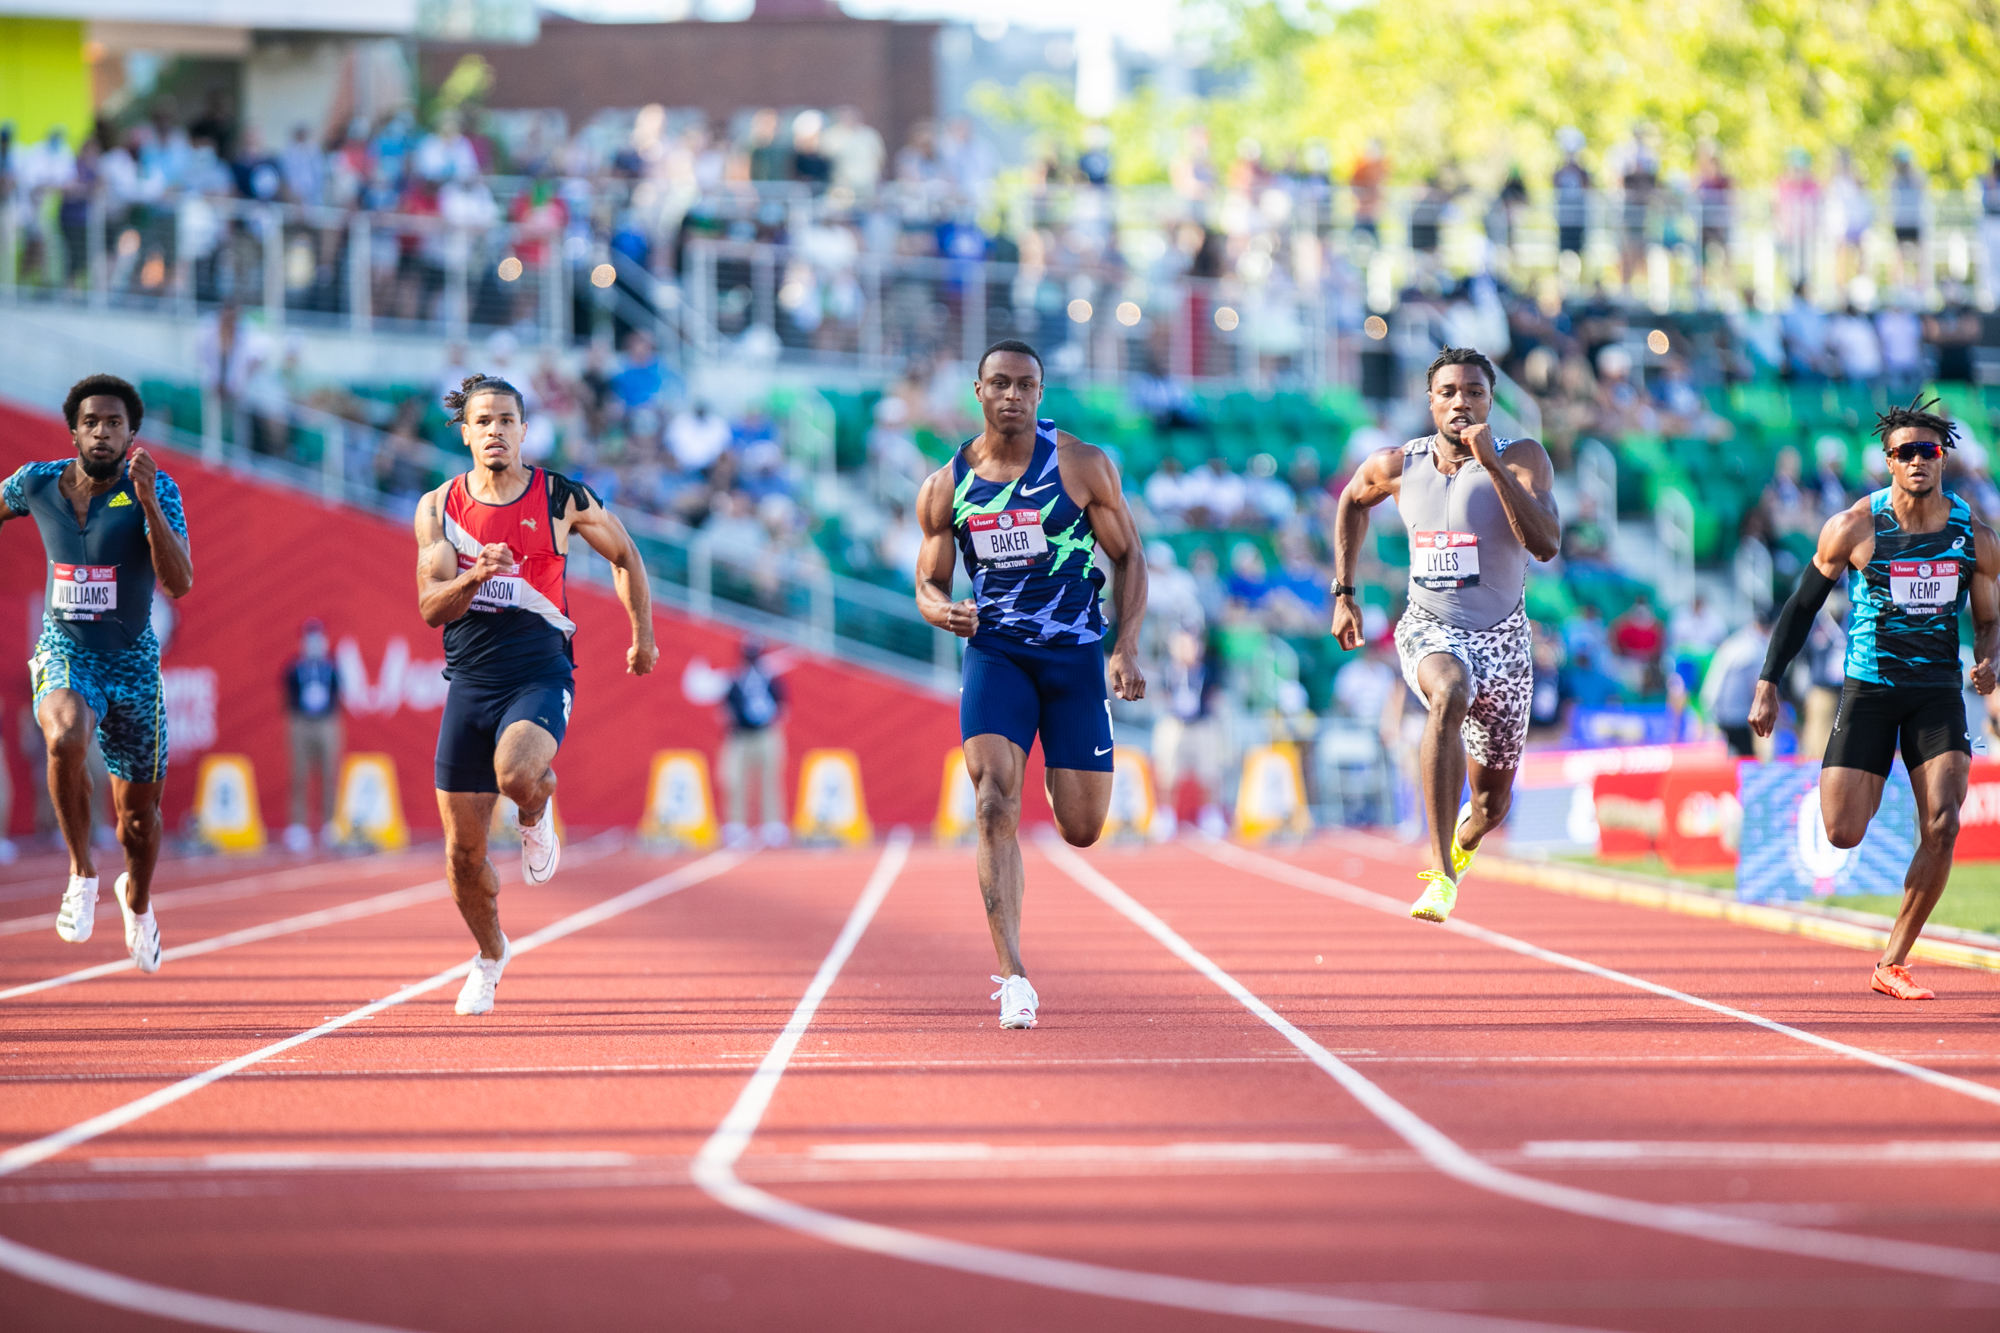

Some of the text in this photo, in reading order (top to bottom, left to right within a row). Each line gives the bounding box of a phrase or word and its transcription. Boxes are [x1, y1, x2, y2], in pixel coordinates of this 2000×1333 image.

[990, 530, 1030, 553] BAKER
[1427, 552, 1459, 572] LYLES
[58, 586, 109, 605] WILLIAMS
[1909, 581, 1941, 599] KEMP
